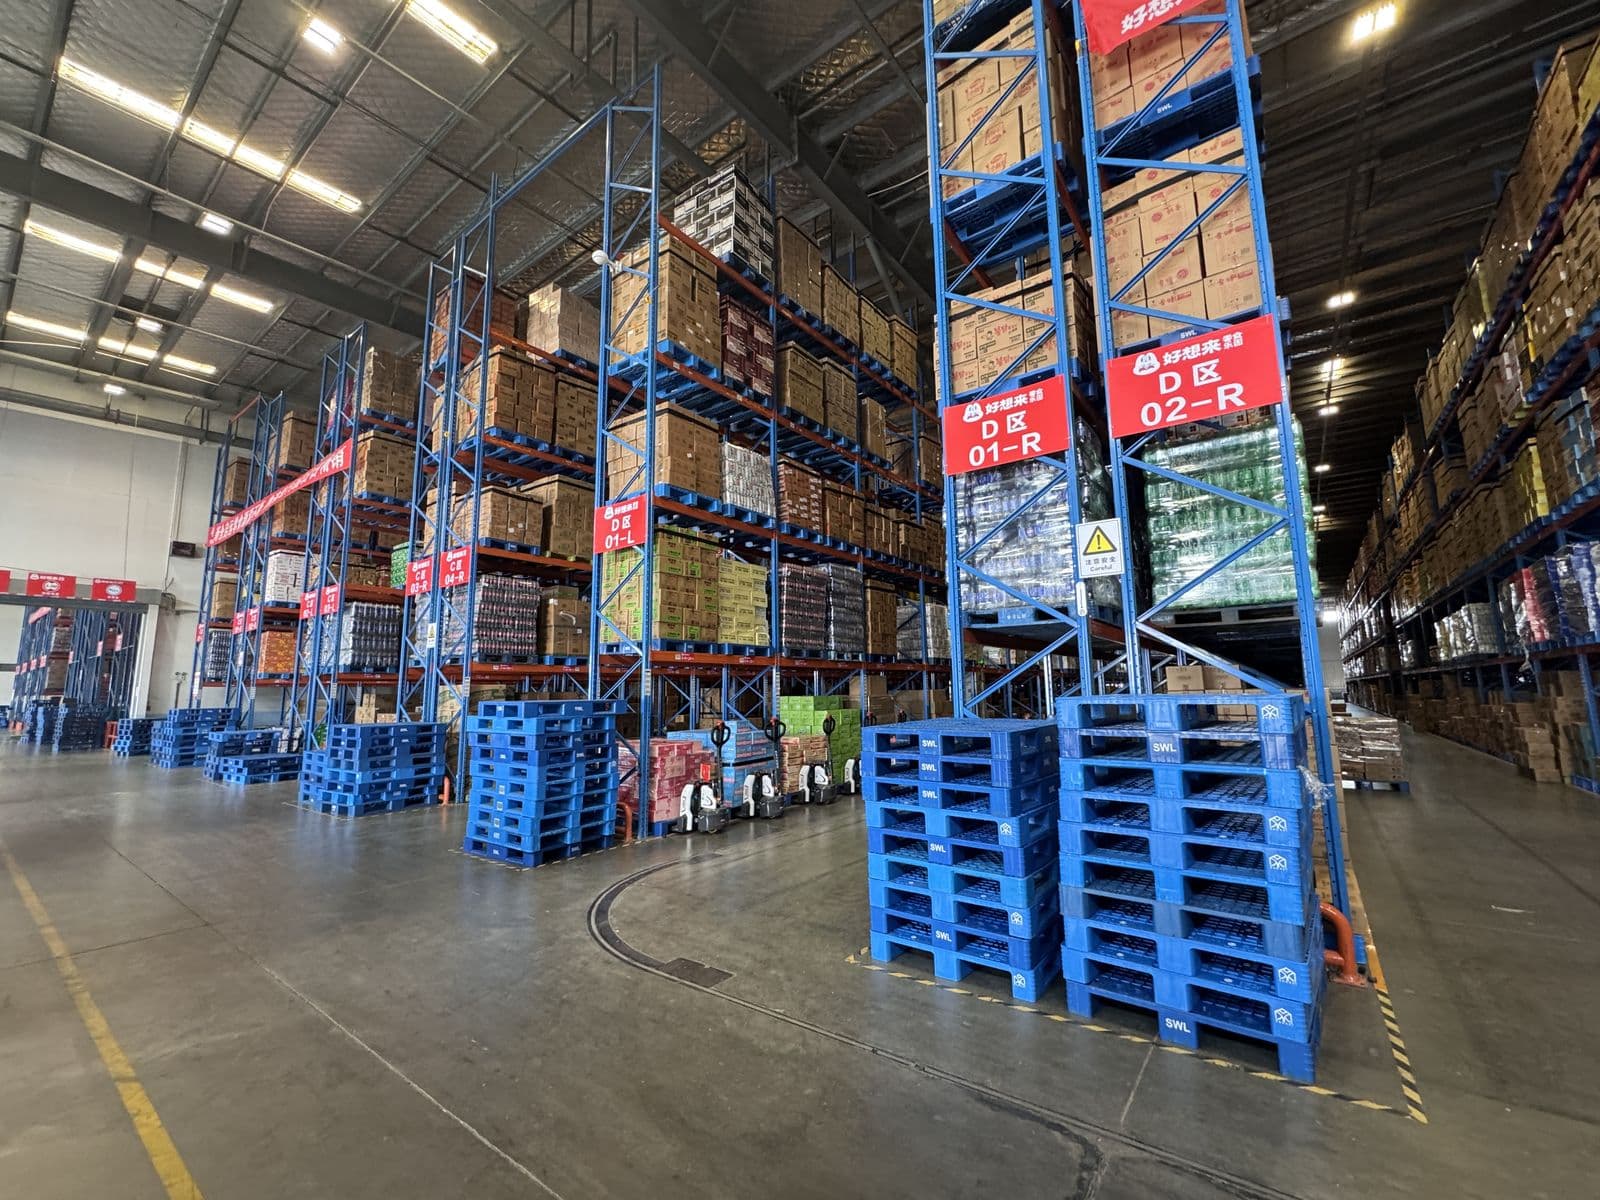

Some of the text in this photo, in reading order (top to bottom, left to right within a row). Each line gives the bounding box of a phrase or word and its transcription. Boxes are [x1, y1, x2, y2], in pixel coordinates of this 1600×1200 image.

[1121, 0, 1184, 35] 好想
[1162, 338, 1222, 366] 好想来
[1159, 358, 1222, 395] D 区
[985, 395, 1029, 415] 好想来
[1140, 382, 1246, 427] 02-R
[982, 410, 1028, 440] D 区
[968, 431, 1042, 467] 01-R
[604, 529, 635, 549] 01-L
[922, 739, 938, 748] SWL
[1152, 742, 1177, 752] SWL
[921, 763, 937, 772] SWL
[922, 790, 938, 799] SWL
[930, 843, 946, 853] SWL
[935, 930, 952, 942] SWL
[1165, 1018, 1191, 1034] SWL
